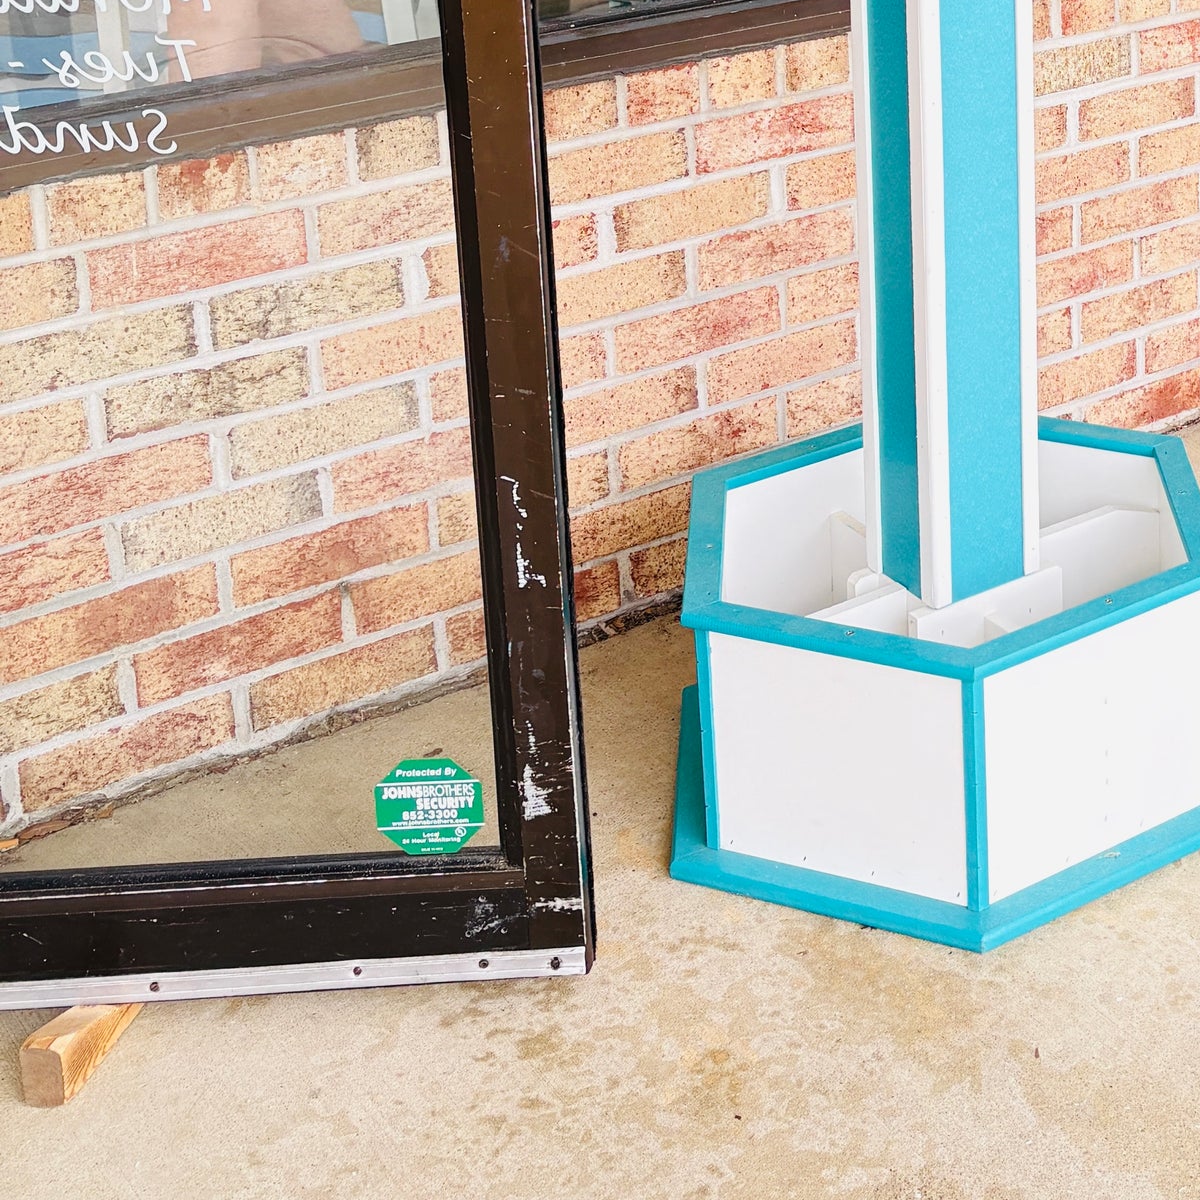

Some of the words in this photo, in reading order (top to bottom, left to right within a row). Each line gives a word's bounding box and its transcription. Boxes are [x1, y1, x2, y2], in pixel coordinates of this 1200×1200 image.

[395, 768, 442, 778] Protected
[444, 767, 457, 777] By
[415, 796, 475, 810] SECURITY
